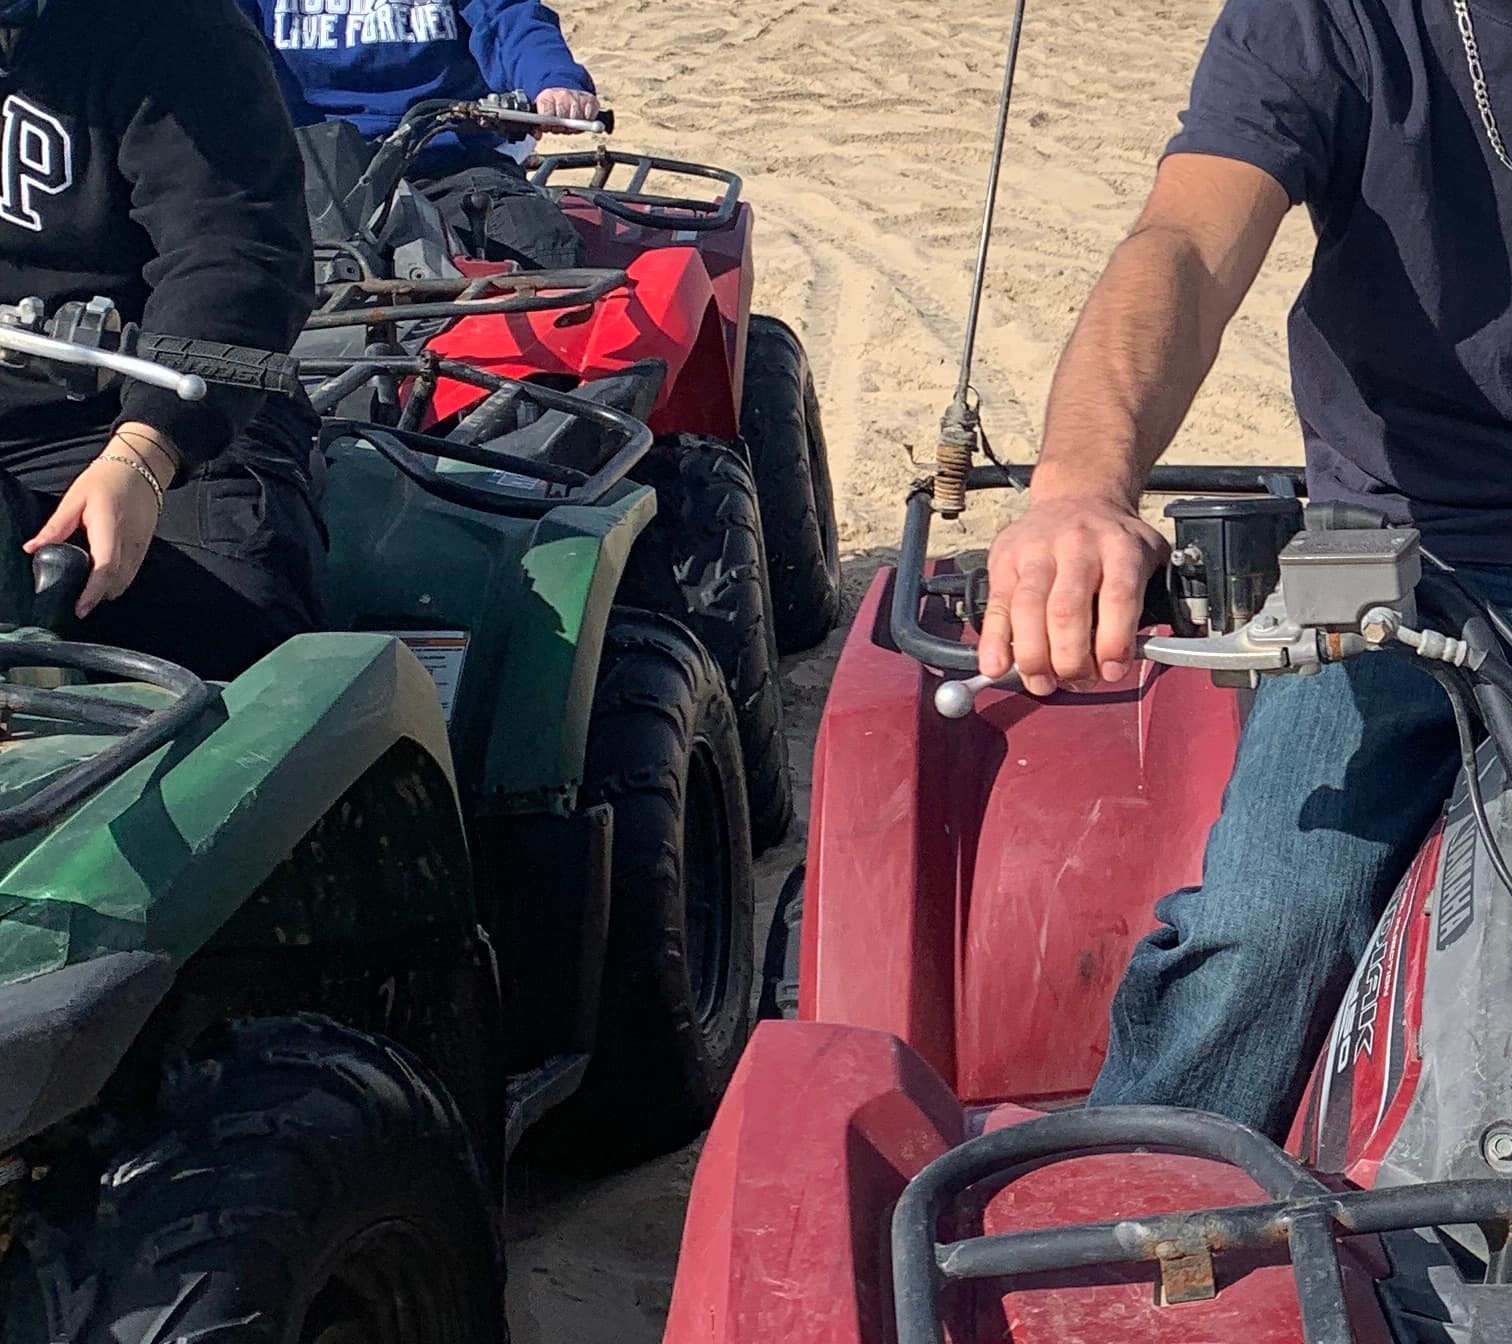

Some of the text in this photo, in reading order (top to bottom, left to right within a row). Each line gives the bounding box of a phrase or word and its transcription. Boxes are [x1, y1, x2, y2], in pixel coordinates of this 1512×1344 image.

[274, 2, 458, 50] LIVE FOREVER
[1438, 815, 1477, 946] YAMAHA
